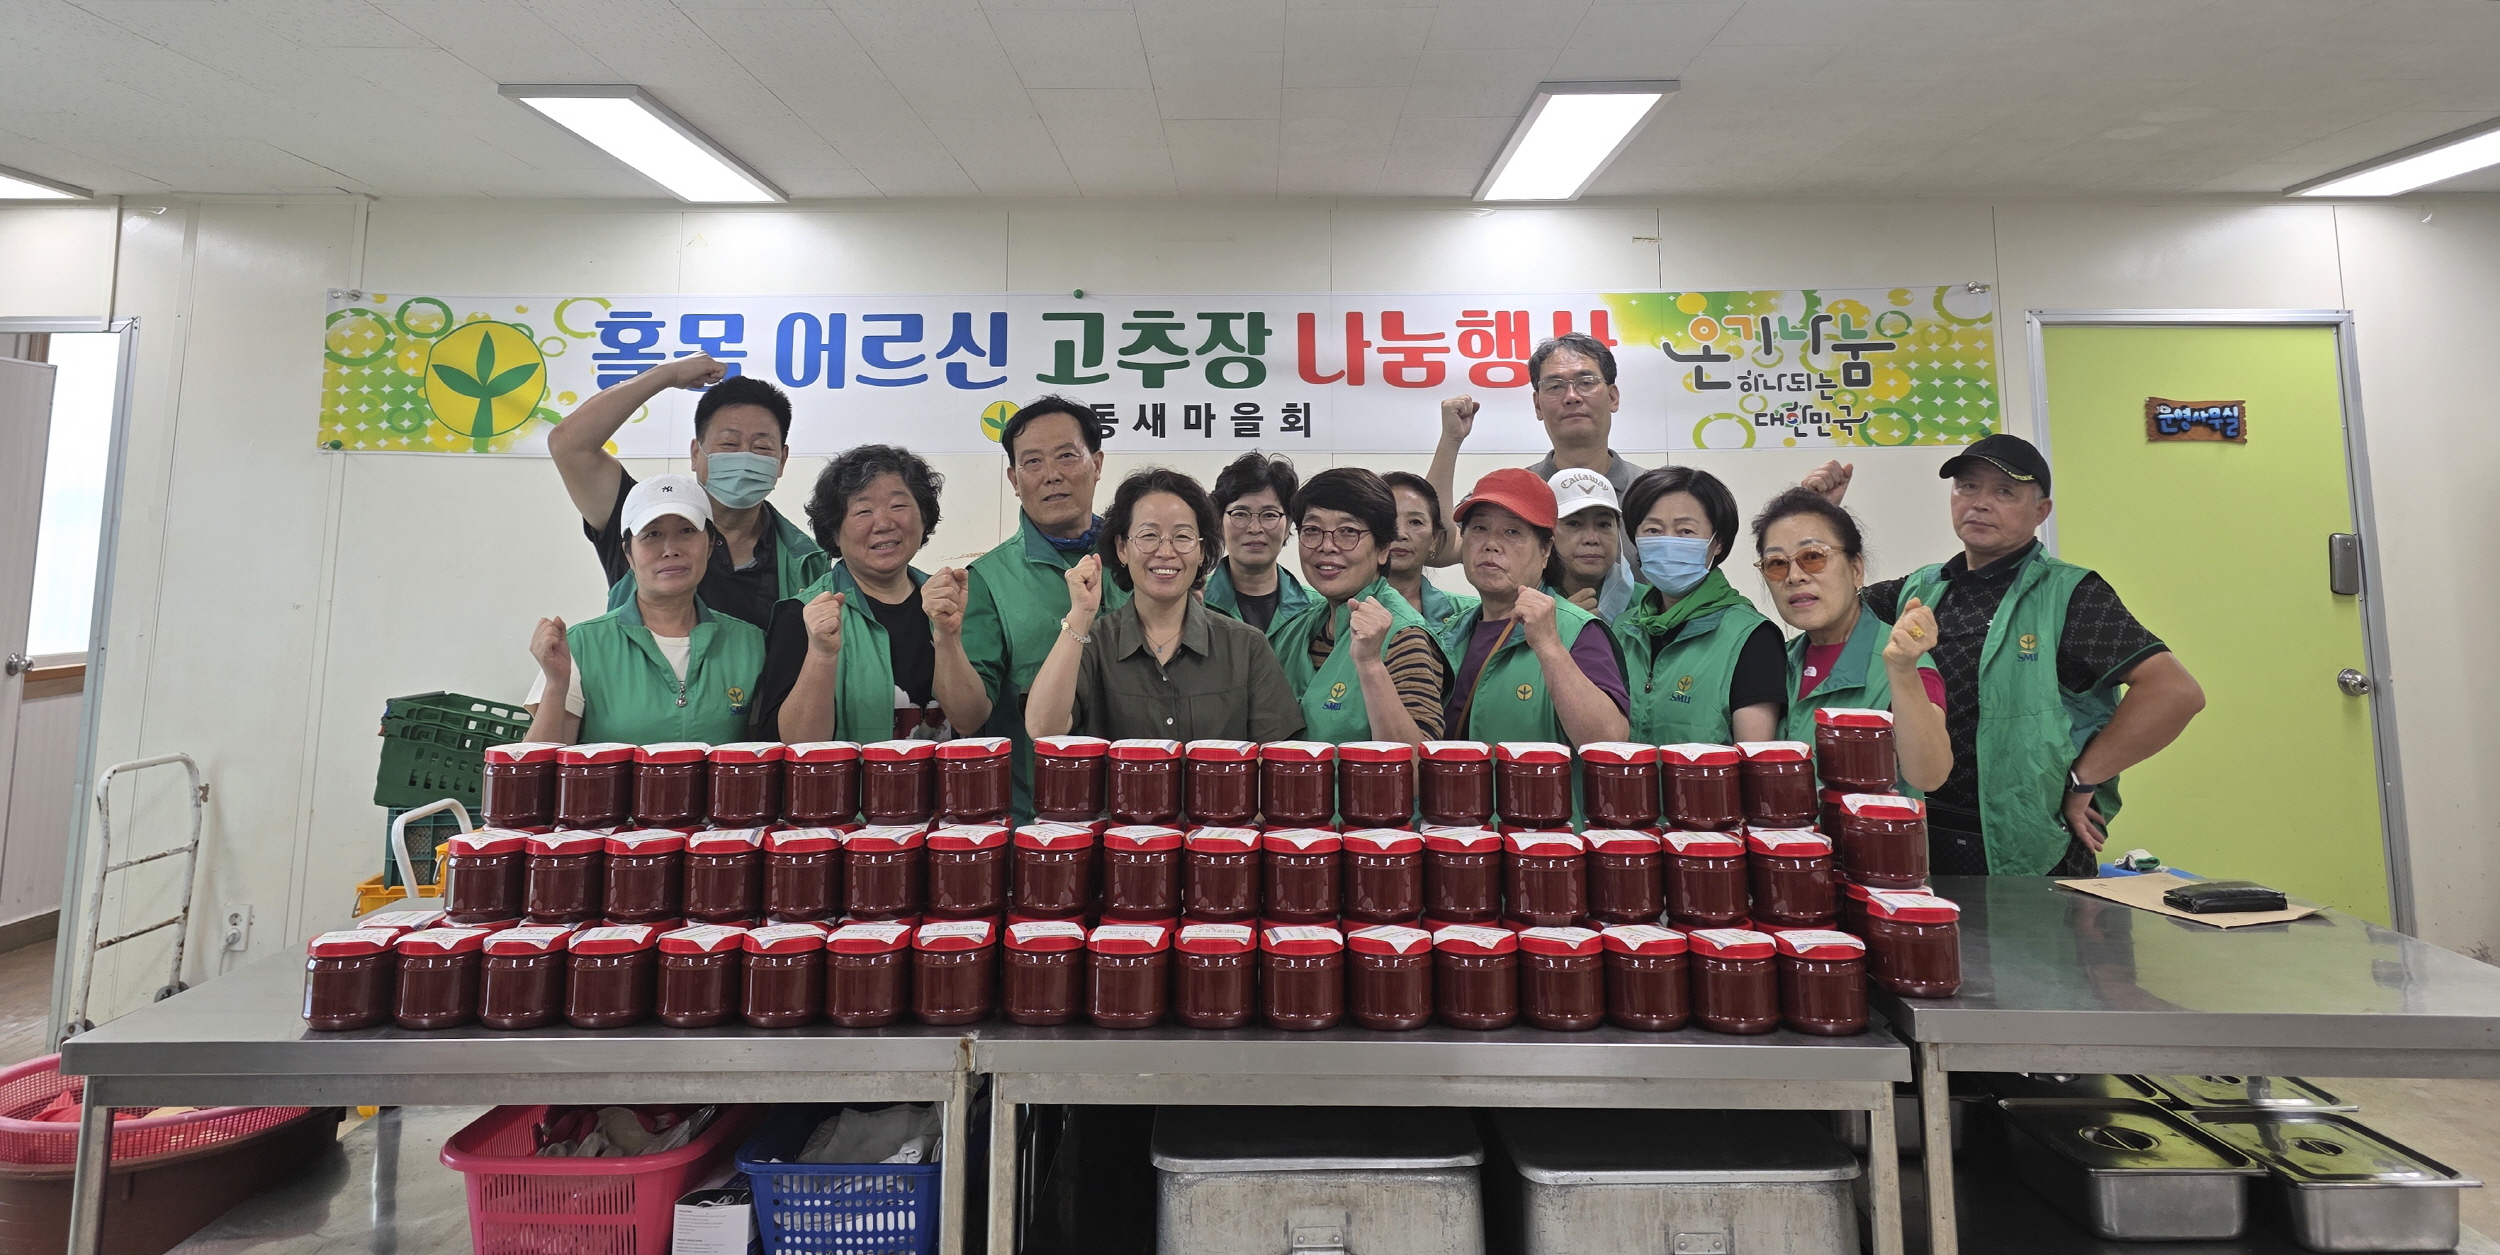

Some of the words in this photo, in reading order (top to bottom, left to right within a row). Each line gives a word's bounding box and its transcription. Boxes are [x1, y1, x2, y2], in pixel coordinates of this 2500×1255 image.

[591, 311, 748, 393] 홀몸
[775, 311, 1008, 390] 어르신
[1035, 309, 1273, 389] 고추장
[1737, 369, 1838, 401] 하나되는
[1754, 401, 1869, 438] 대한민국
[2156, 404, 2240, 437] 운영사무실
[1560, 472, 1609, 491] Callaway
[2017, 652, 2039, 662] SMU
[1669, 692, 1692, 705] SMU
